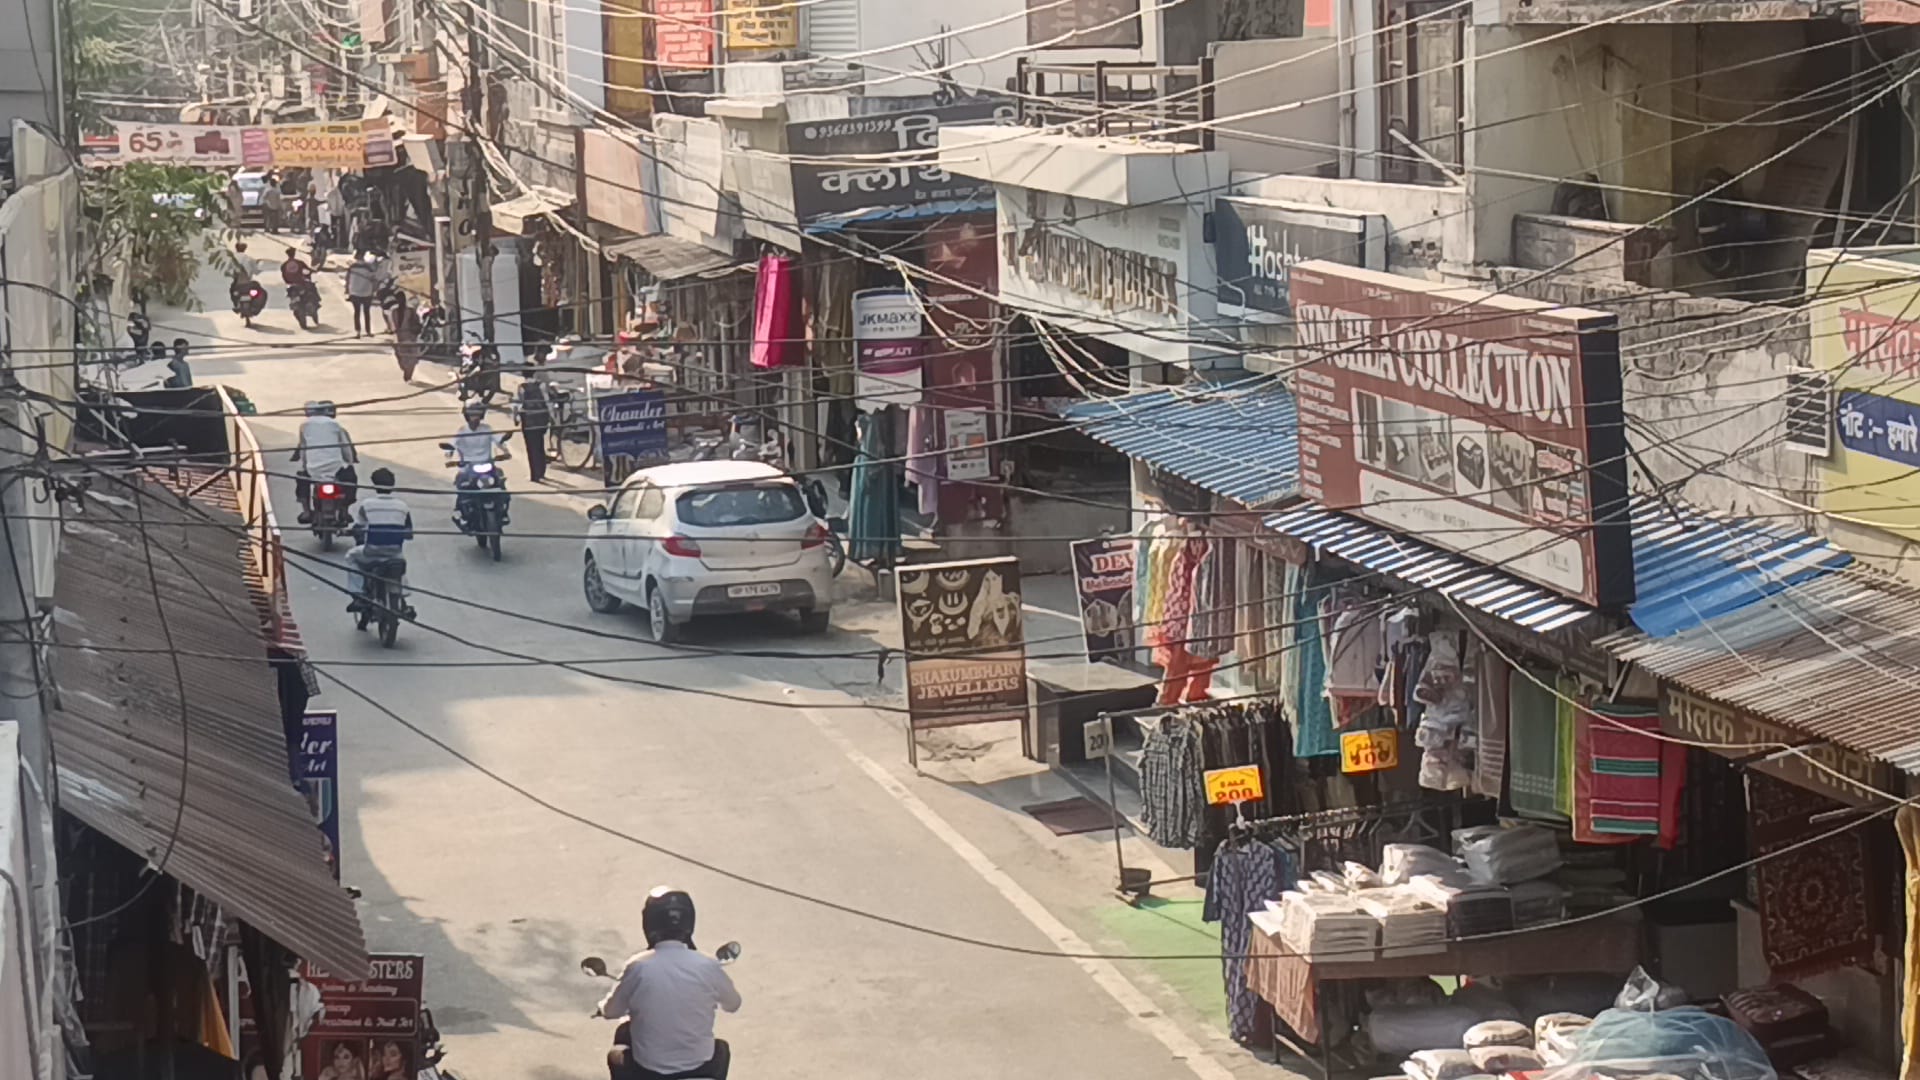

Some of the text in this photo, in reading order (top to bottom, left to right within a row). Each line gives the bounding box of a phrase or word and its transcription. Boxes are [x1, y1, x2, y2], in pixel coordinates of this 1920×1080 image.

[129, 132, 164, 153] 65
[273, 136, 327, 152] SCHOOL
[328, 135, 363, 151] BAGS
[1397, 321, 1574, 429] COLLECTION
[601, 402, 663, 422] Chander
[918, 677, 1020, 700] JEWELLERS
[1219, 778, 1246, 788] SALE
